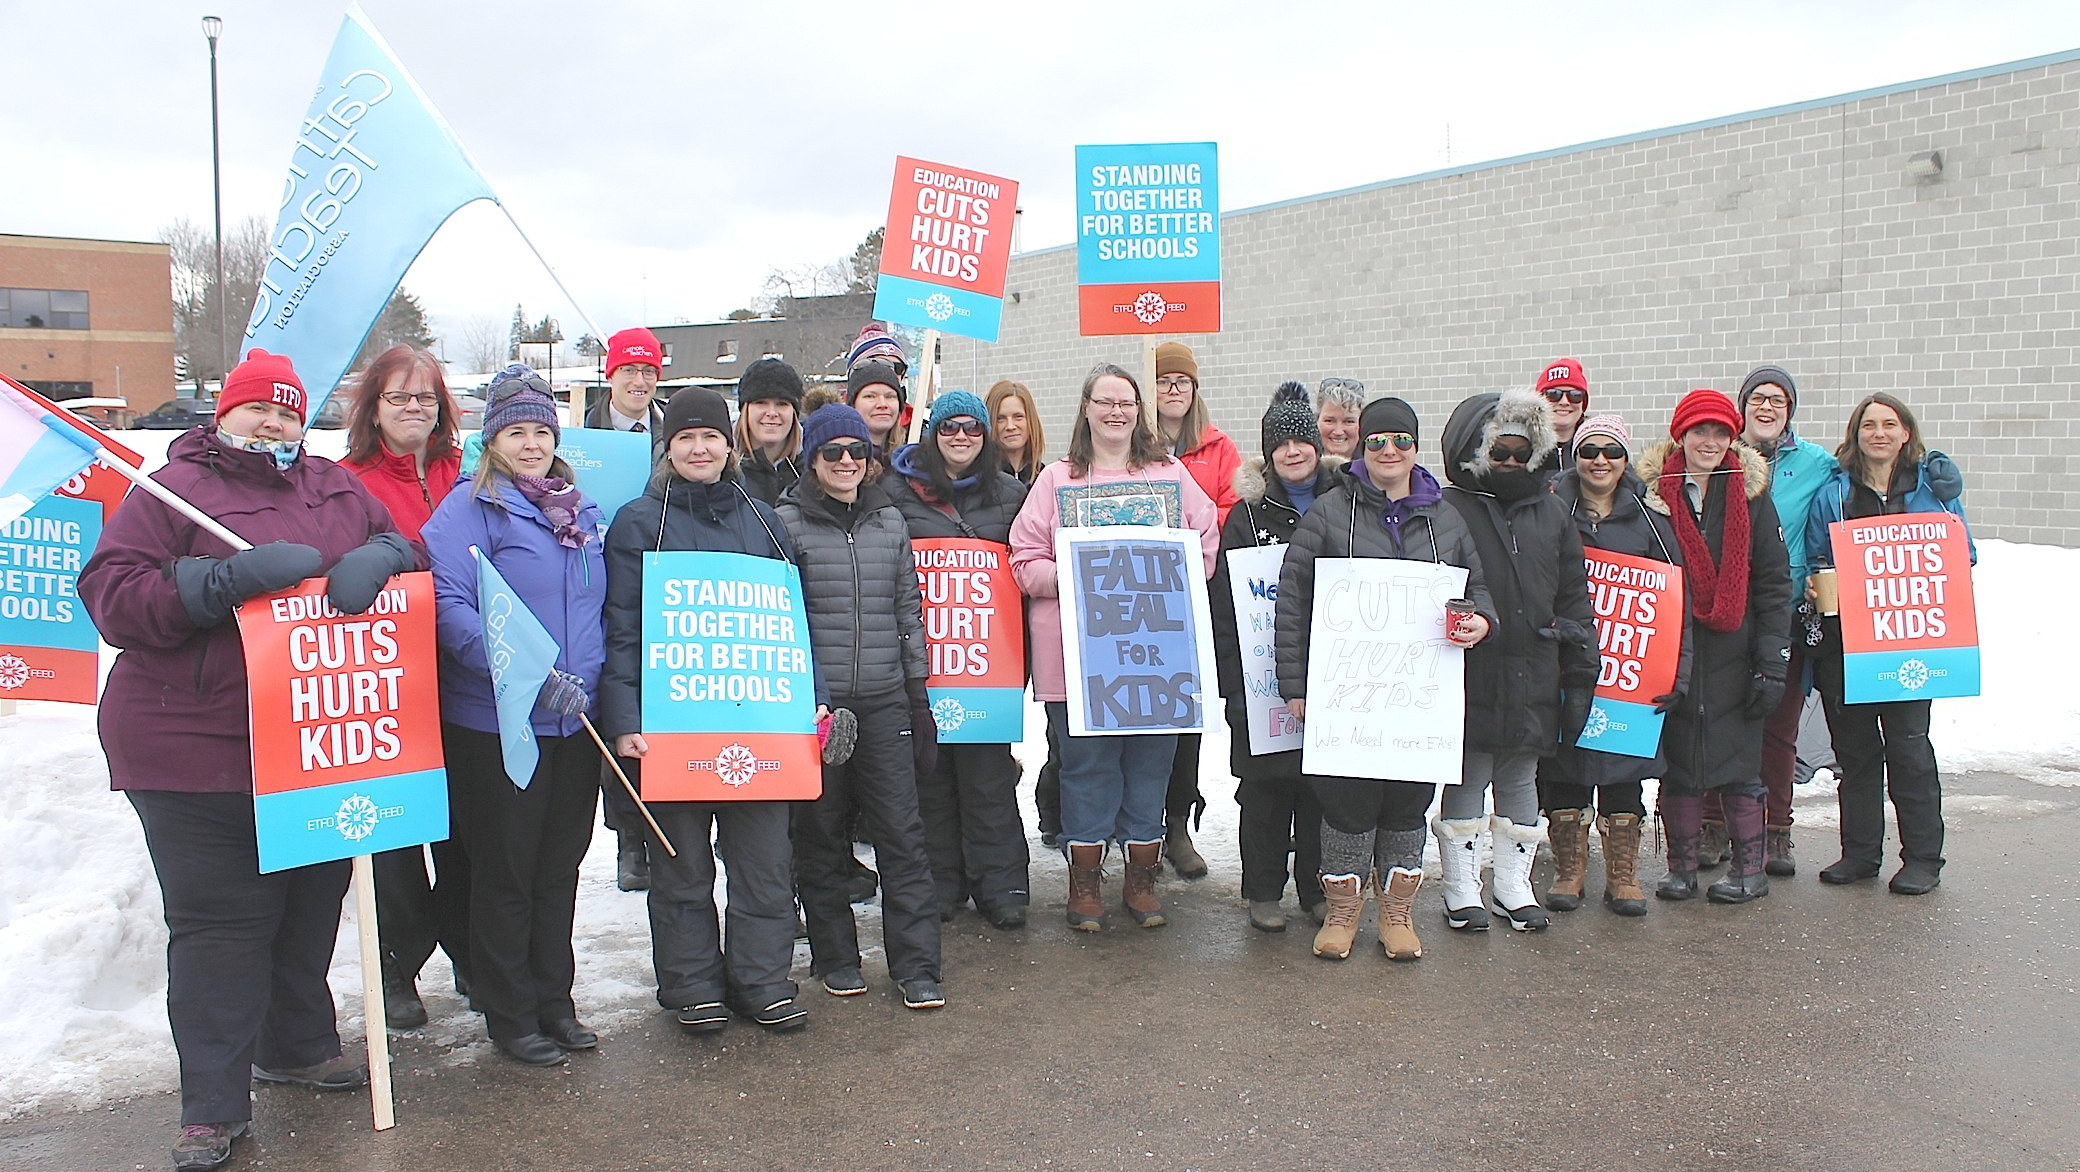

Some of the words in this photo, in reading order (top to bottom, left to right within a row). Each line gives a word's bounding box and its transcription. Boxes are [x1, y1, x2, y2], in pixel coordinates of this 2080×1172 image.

[914, 167, 1000, 199] EDUCATION
[1092, 163, 1201, 187] STANDING
[917, 187, 990, 226] CUTS
[1091, 188, 1203, 211] TOGETHER
[910, 215, 989, 254] HURT
[1083, 214, 1124, 236] FOR
[1130, 212, 1213, 235] BETTER
[911, 244, 979, 282] KIDS
[1098, 237, 1198, 260] SCHOOLS
[907, 297, 925, 308] ETFO
[1113, 304, 1133, 313] ETFO
[1167, 303, 1186, 312] FEEO
[1548, 366, 1569, 381] ETFO
[272, 382, 302, 409] ETFO
[554, 448, 587, 458] atholic
[568, 458, 603, 468] eachers
[1852, 523, 1948, 545] EDUCATION
[913, 550, 999, 569] DUCATION
[1078, 546, 1184, 592] FAIR
[1864, 542, 1943, 576] CUTS
[0, 569, 80, 598] ETTE
[1584, 559, 1667, 590] DUCATION
[270, 588, 408, 623] EDUCON
[664, 579, 792, 611] STANDING
[1322, 576, 1452, 632] CUTS
[1865, 575, 1948, 608] HURT
[1, 595, 73, 623] OOLS
[923, 607, 994, 639] URT
[1084, 593, 1184, 637] DEAL
[1249, 612, 1274, 632] WA
[662, 611, 795, 643] TOGETHER
[1872, 607, 1947, 641] KIDS
[290, 620, 398, 671] CUTS
[650, 643, 704, 669] FOR
[712, 644, 807, 673] BETTER
[927, 643, 989, 676] IDS
[1115, 641, 1165, 666] FOR
[1324, 638, 1450, 682] HURT
[31, 669, 55, 679] FEEO
[1596, 654, 1643, 691] DS
[1878, 672, 1897, 681] ETFO
[1929, 670, 1947, 678] FEEO
[291, 667, 404, 722] HURT
[669, 675, 792, 703] SCHOOLS
[1088, 672, 1200, 727] KIDS
[1325, 681, 1439, 713] KIDS
[966, 711, 987, 719] FEEO
[1608, 721, 1628, 732] FEEO
[300, 717, 401, 771] KIDS
[1315, 726, 1341, 748] We
[1350, 726, 1382, 748] Need
[688, 761, 713, 770] ETFO
[758, 761, 781, 770] FEEO
[308, 818, 335, 831] ETFO
[379, 805, 404, 818] FEEO
